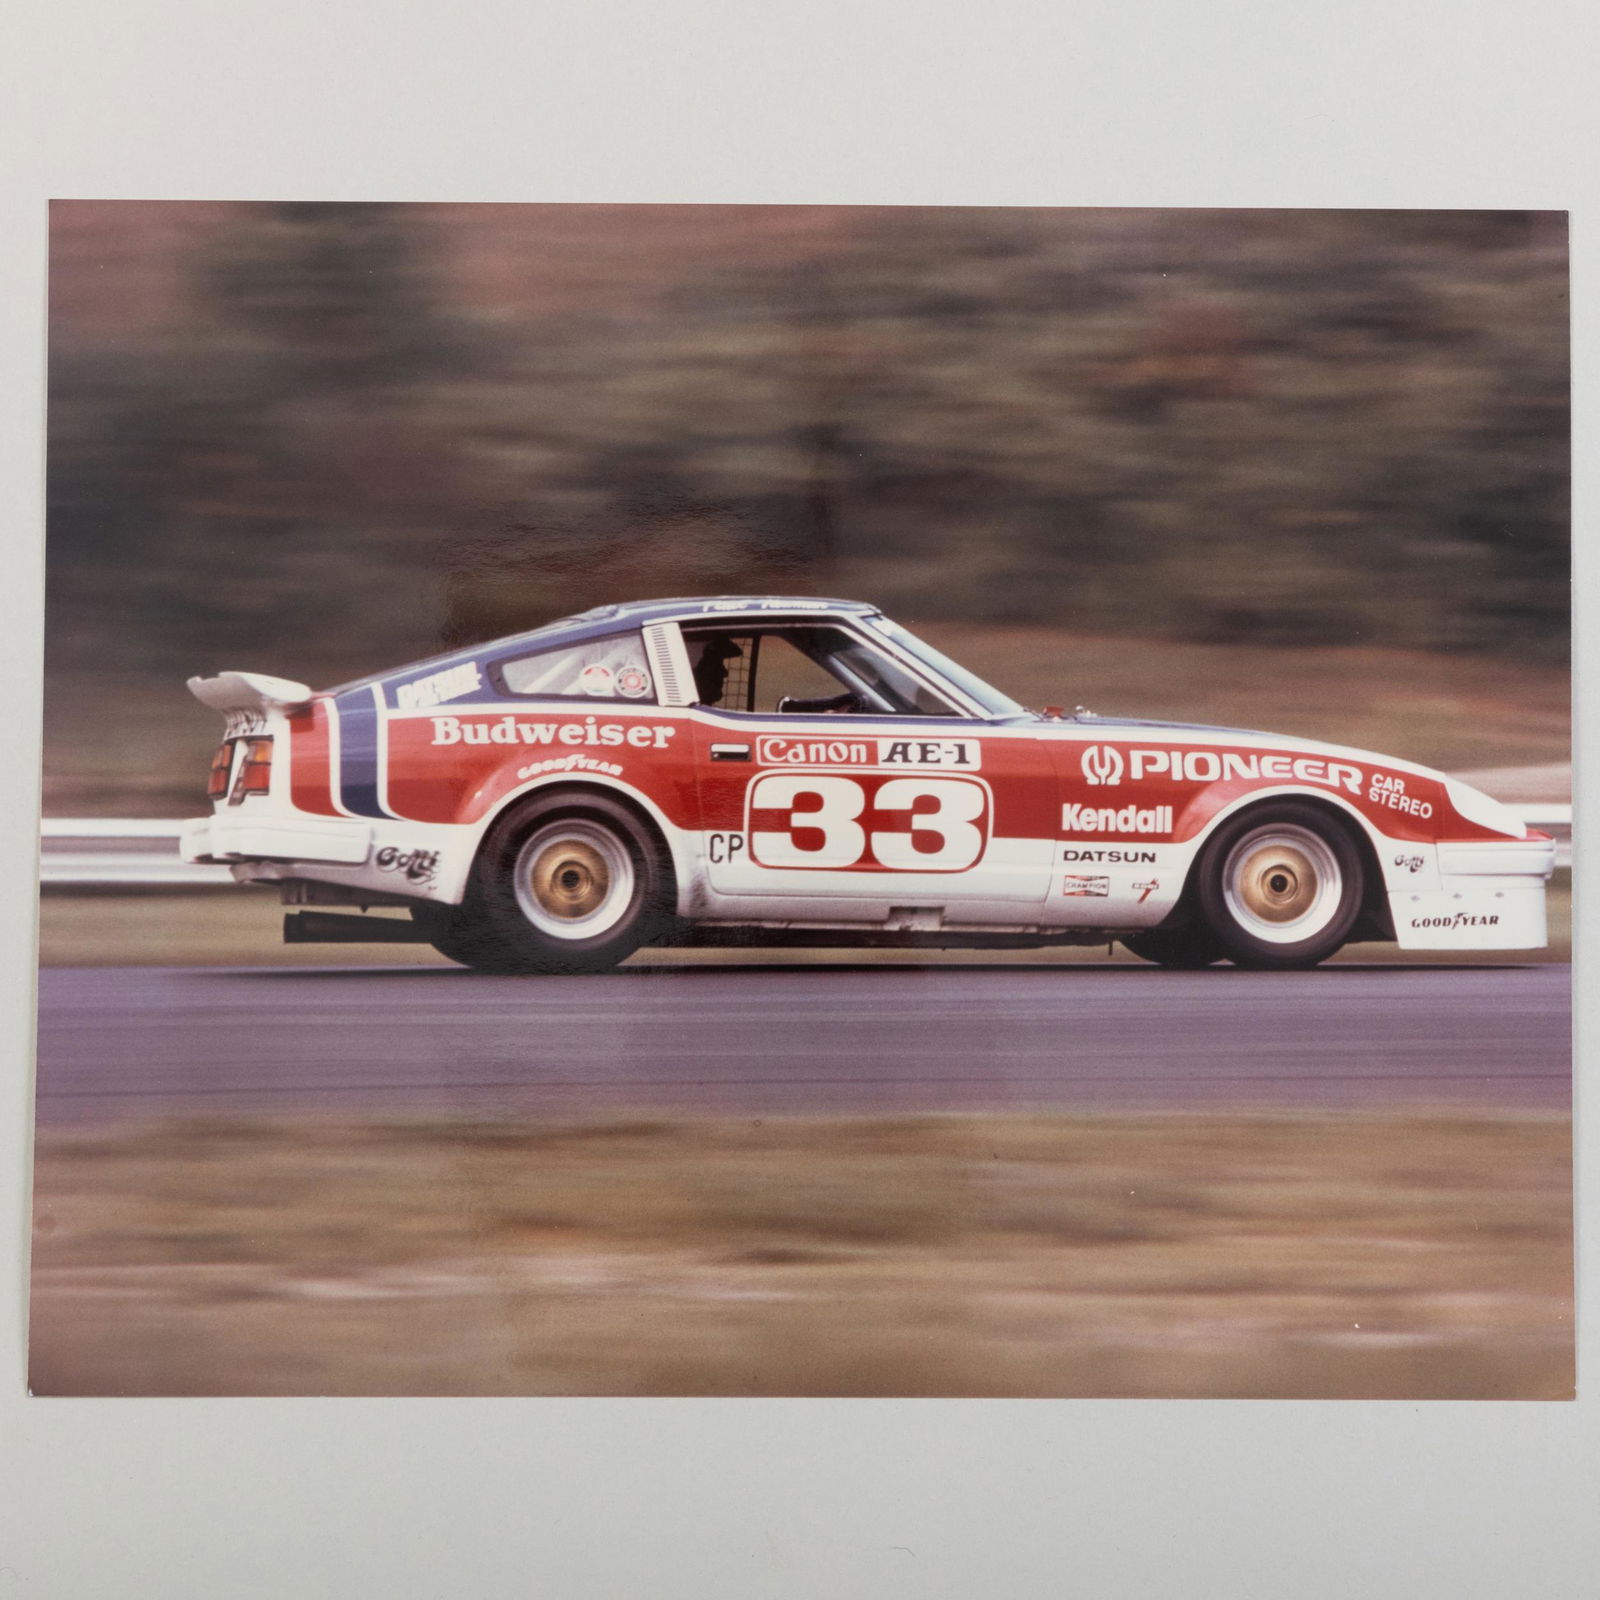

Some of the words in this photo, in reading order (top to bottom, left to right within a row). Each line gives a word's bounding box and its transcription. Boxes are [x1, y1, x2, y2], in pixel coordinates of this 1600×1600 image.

[430, 716, 676, 748] Budweiser
[763, 739, 867, 763] Canon
[881, 742, 970, 764] AE-1
[1129, 750, 1363, 795] PIONEER
[1371, 773, 1405, 794] CAR
[1061, 803, 1173, 834] Kendall
[1369, 787, 1432, 819] STEREO
[752, 775, 985, 871] 33
[709, 833, 743, 864] CP
[1063, 850, 1156, 863] DATSUN
[1411, 912, 1499, 930] GOODYEAR
